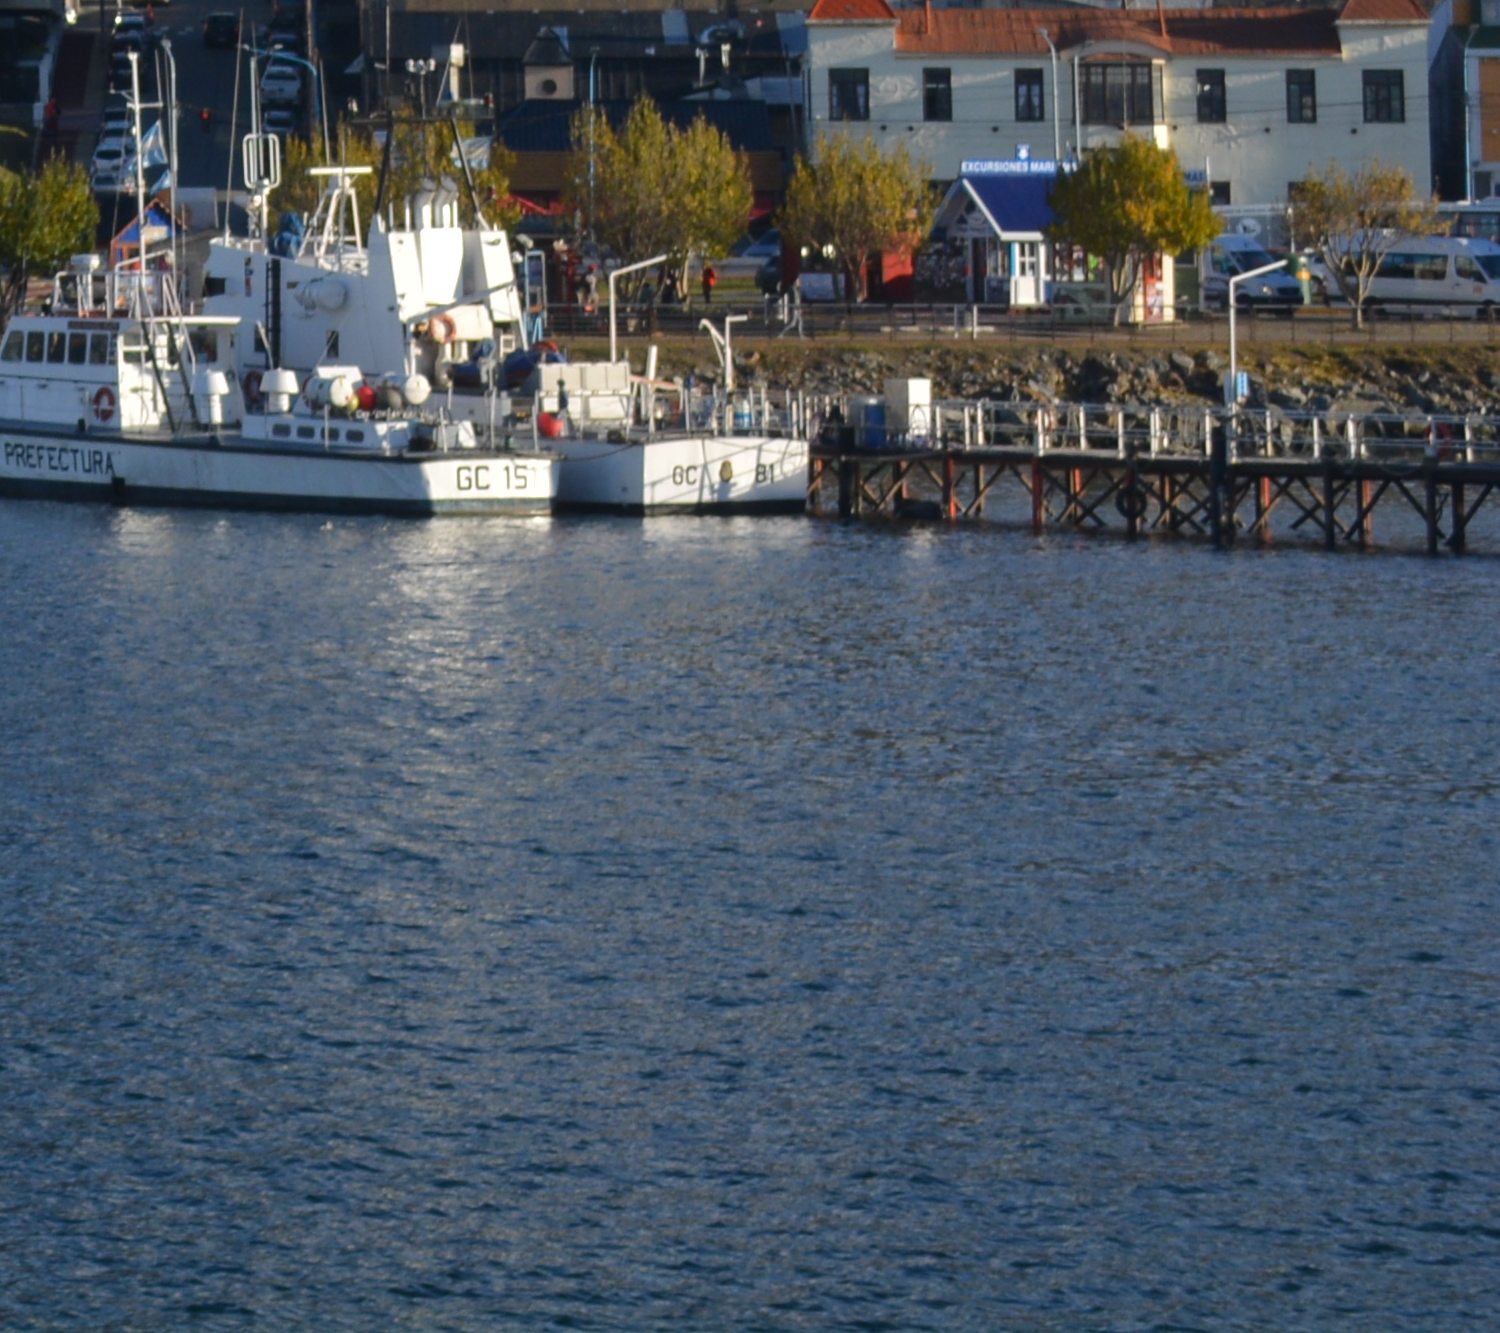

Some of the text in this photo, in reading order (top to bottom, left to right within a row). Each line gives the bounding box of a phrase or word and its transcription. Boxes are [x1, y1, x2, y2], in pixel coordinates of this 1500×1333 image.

[961, 160, 1028, 173] EXCURSIONES
[4, 443, 115, 476] PREFECTURA
[456, 466, 491, 490] GC
[671, 463, 776, 485] GC 81
